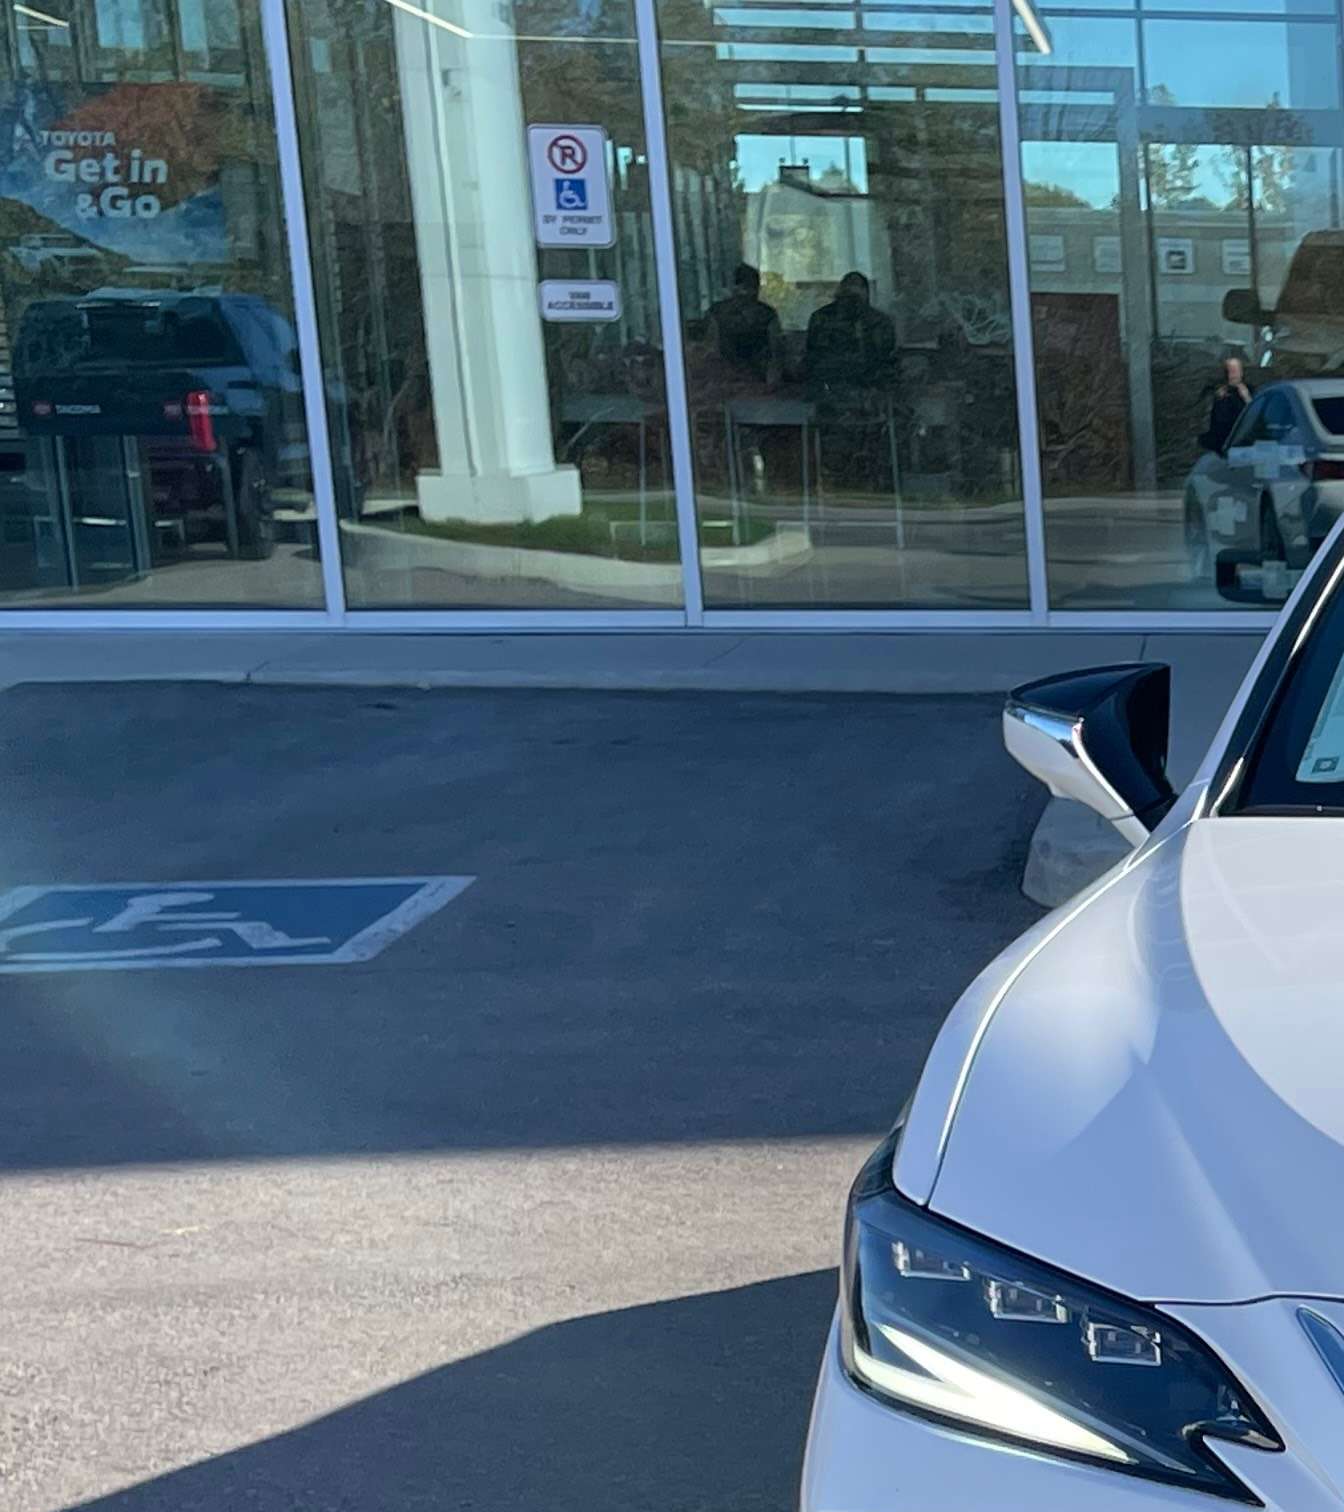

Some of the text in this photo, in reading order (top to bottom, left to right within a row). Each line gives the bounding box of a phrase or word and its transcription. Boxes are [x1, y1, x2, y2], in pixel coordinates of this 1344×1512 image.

[40, 130, 116, 146] TOYOTA
[45, 149, 168, 183] Get in
